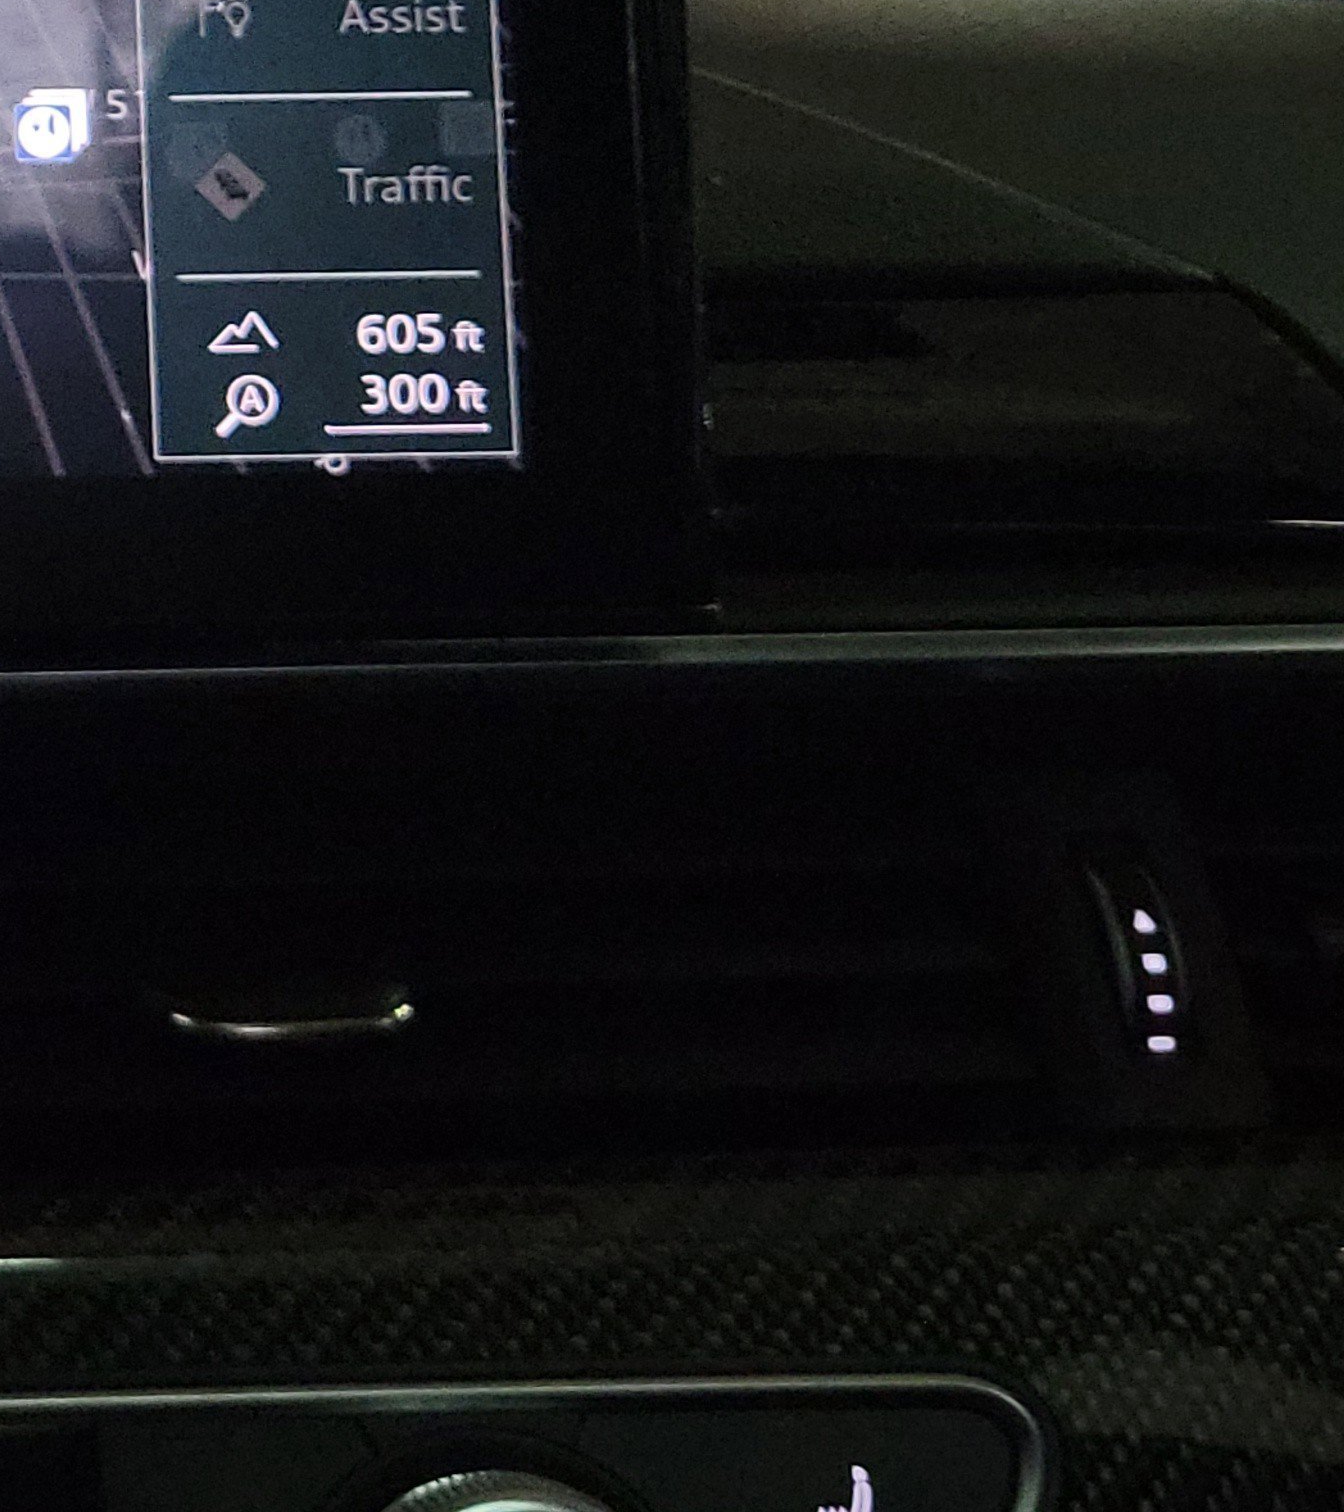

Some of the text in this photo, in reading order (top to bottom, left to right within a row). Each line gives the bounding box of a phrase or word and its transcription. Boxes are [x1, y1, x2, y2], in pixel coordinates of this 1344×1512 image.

[337, 165, 473, 206] Traffic
[356, 313, 487, 354] 605 ft
[360, 373, 490, 414] 300 ft
